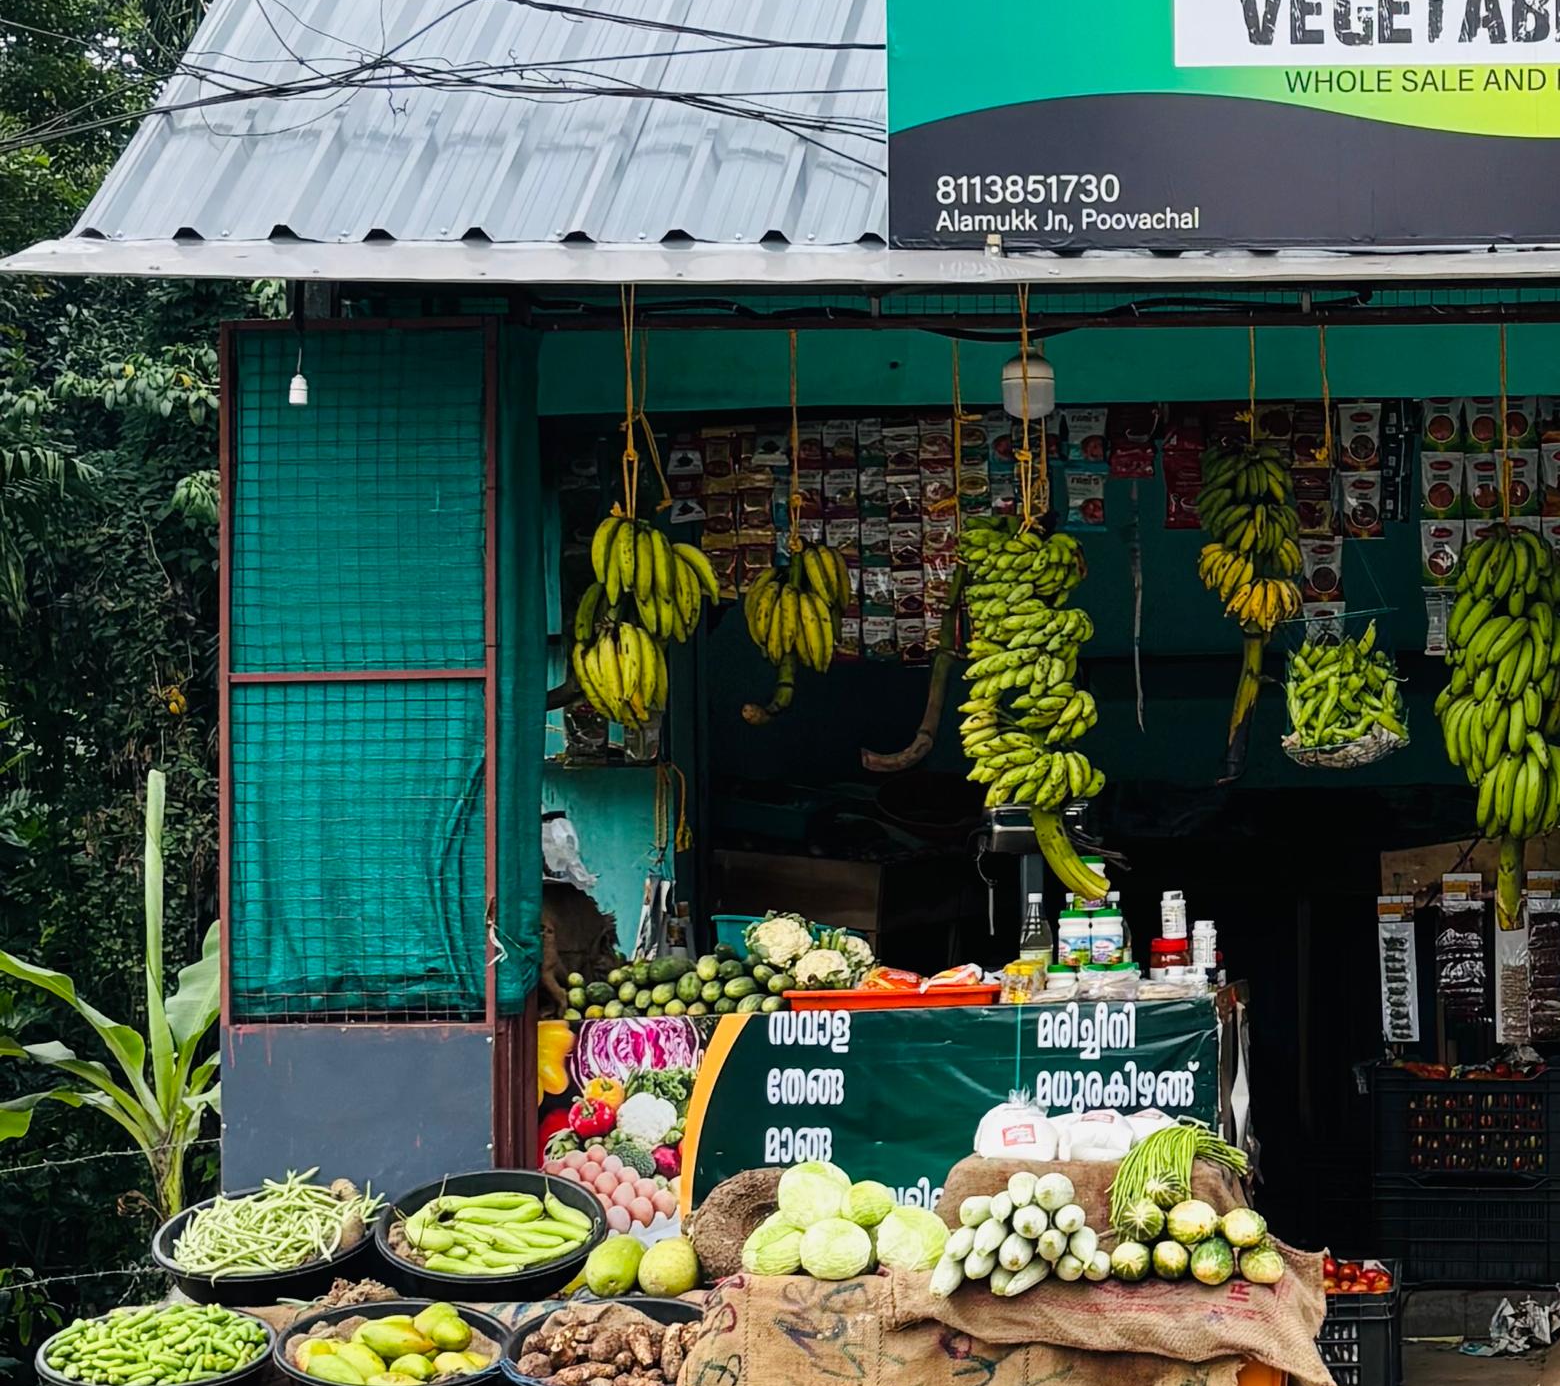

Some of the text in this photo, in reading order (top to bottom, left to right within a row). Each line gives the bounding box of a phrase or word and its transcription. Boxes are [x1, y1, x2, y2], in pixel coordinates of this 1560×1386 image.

[1284, 70, 1392, 94] WHOLE
[1401, 69, 1474, 93] SALE
[1484, 68, 1547, 92] AND
[936, 173, 1120, 205] 8113851730
[935, 206, 1200, 234] Alamukk Jn, Poovachal
[768, 1009, 852, 1054] സവാള
[766, 1066, 845, 1106] തേങ്ങ
[764, 1126, 833, 1164] മാങ്ങ
